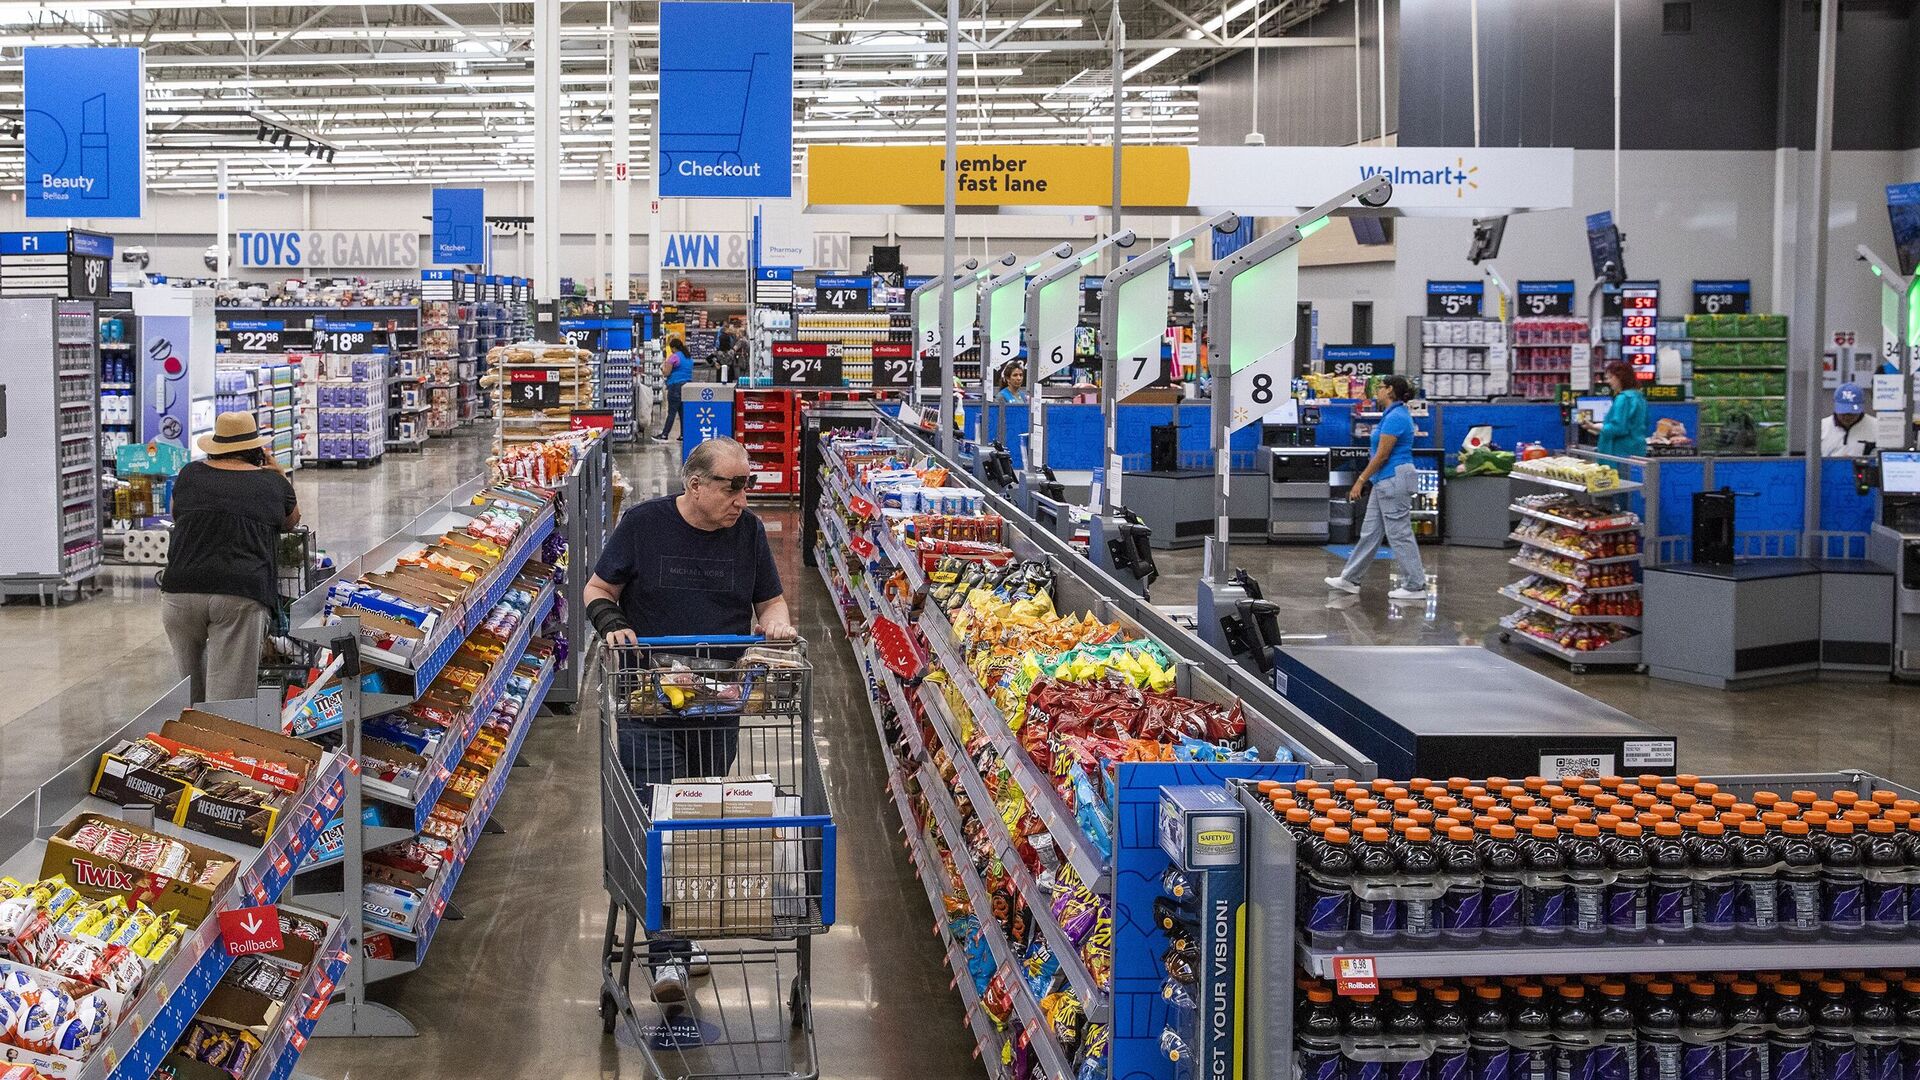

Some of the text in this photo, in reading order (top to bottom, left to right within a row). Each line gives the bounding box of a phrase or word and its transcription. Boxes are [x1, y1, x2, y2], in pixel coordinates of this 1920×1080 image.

[678, 160, 761, 177] Checkout
[42, 174, 94, 192] Beauty
[958, 173, 1048, 192] fast lane
[22, 236, 39, 251] F1
[239, 232, 417, 266] TOYS & GAMES
[440, 244, 466, 252] Kitchen
[661, 234, 746, 268] AWN &
[769, 246, 803, 254] Pharmacy
[766, 270, 778, 279] G1
[1635, 298, 1652, 308] 54
[1626, 316, 1652, 327] 203
[926, 331, 935, 342] 3
[955, 335, 966, 347] 4
[1001, 340, 1011, 356] 5
[1051, 349, 1063, 364] 6
[1634, 354, 1651, 364] 27
[1133, 357, 1148, 380] 7
[524, 384, 543, 400] $1
[1252, 373, 1274, 404] 8
[1647, 387, 1678, 396] HERE
[704, 569, 725, 577] KORS
[262, 773, 275, 783] 24
[125, 775, 166, 800] HERSHEY'S
[733, 789, 753, 797] Kidde
[197, 800, 246, 823] HERSHEY'S
[72, 857, 133, 890] Twix
[172, 884, 189, 897] 24
[230, 937, 279, 954] Rollback
[1214, 900, 1229, 977] VISION!
[1352, 959, 1367, 970] 6.98
[1213, 982, 1227, 1042] YOUR
